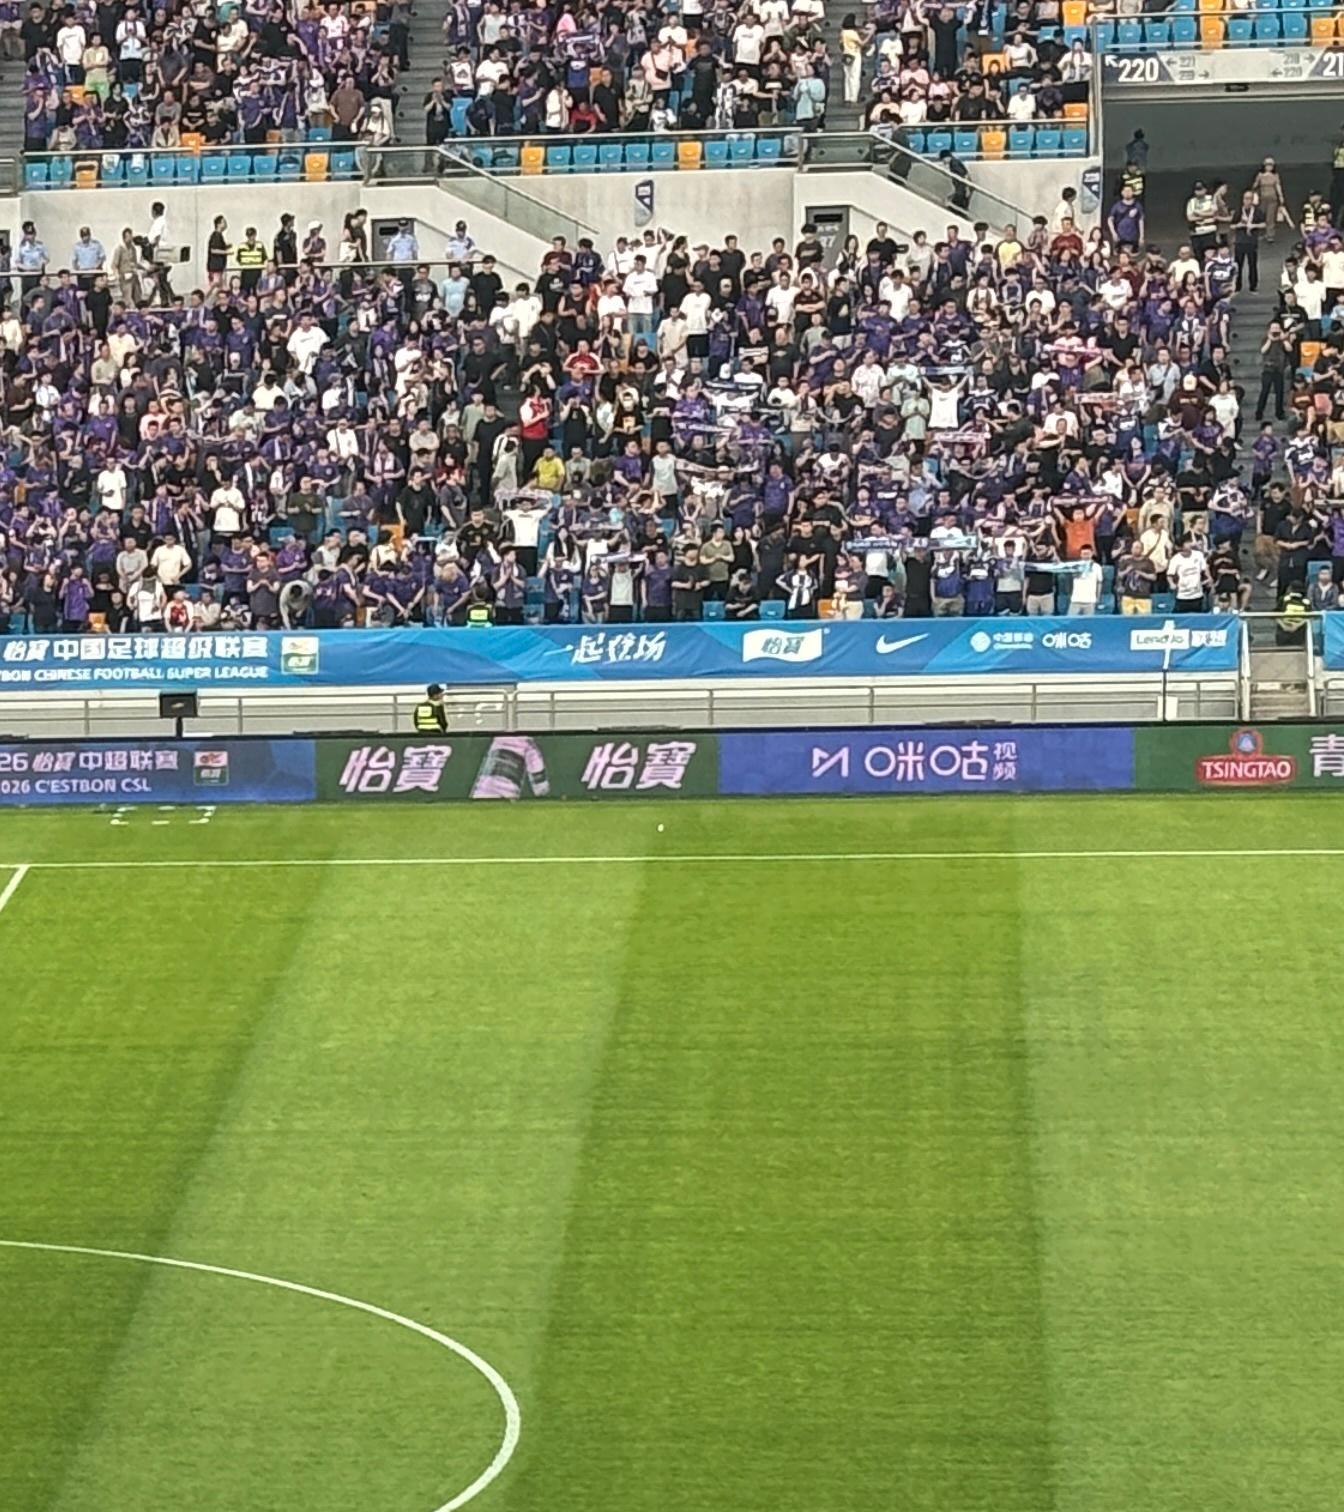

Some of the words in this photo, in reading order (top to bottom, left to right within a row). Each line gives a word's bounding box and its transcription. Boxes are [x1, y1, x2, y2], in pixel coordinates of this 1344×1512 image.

[1118, 58, 1159, 82] 220
[1322, 52, 1344, 77] 21
[94, 667, 164, 680] FOOTBALL
[167, 667, 211, 679] SUPER
[215, 666, 269, 679] LEAGUE
[1202, 761, 1292, 780] TSINGTAO
[35, 778, 116, 794] C'ESTBON
[120, 778, 152, 793] CSL
